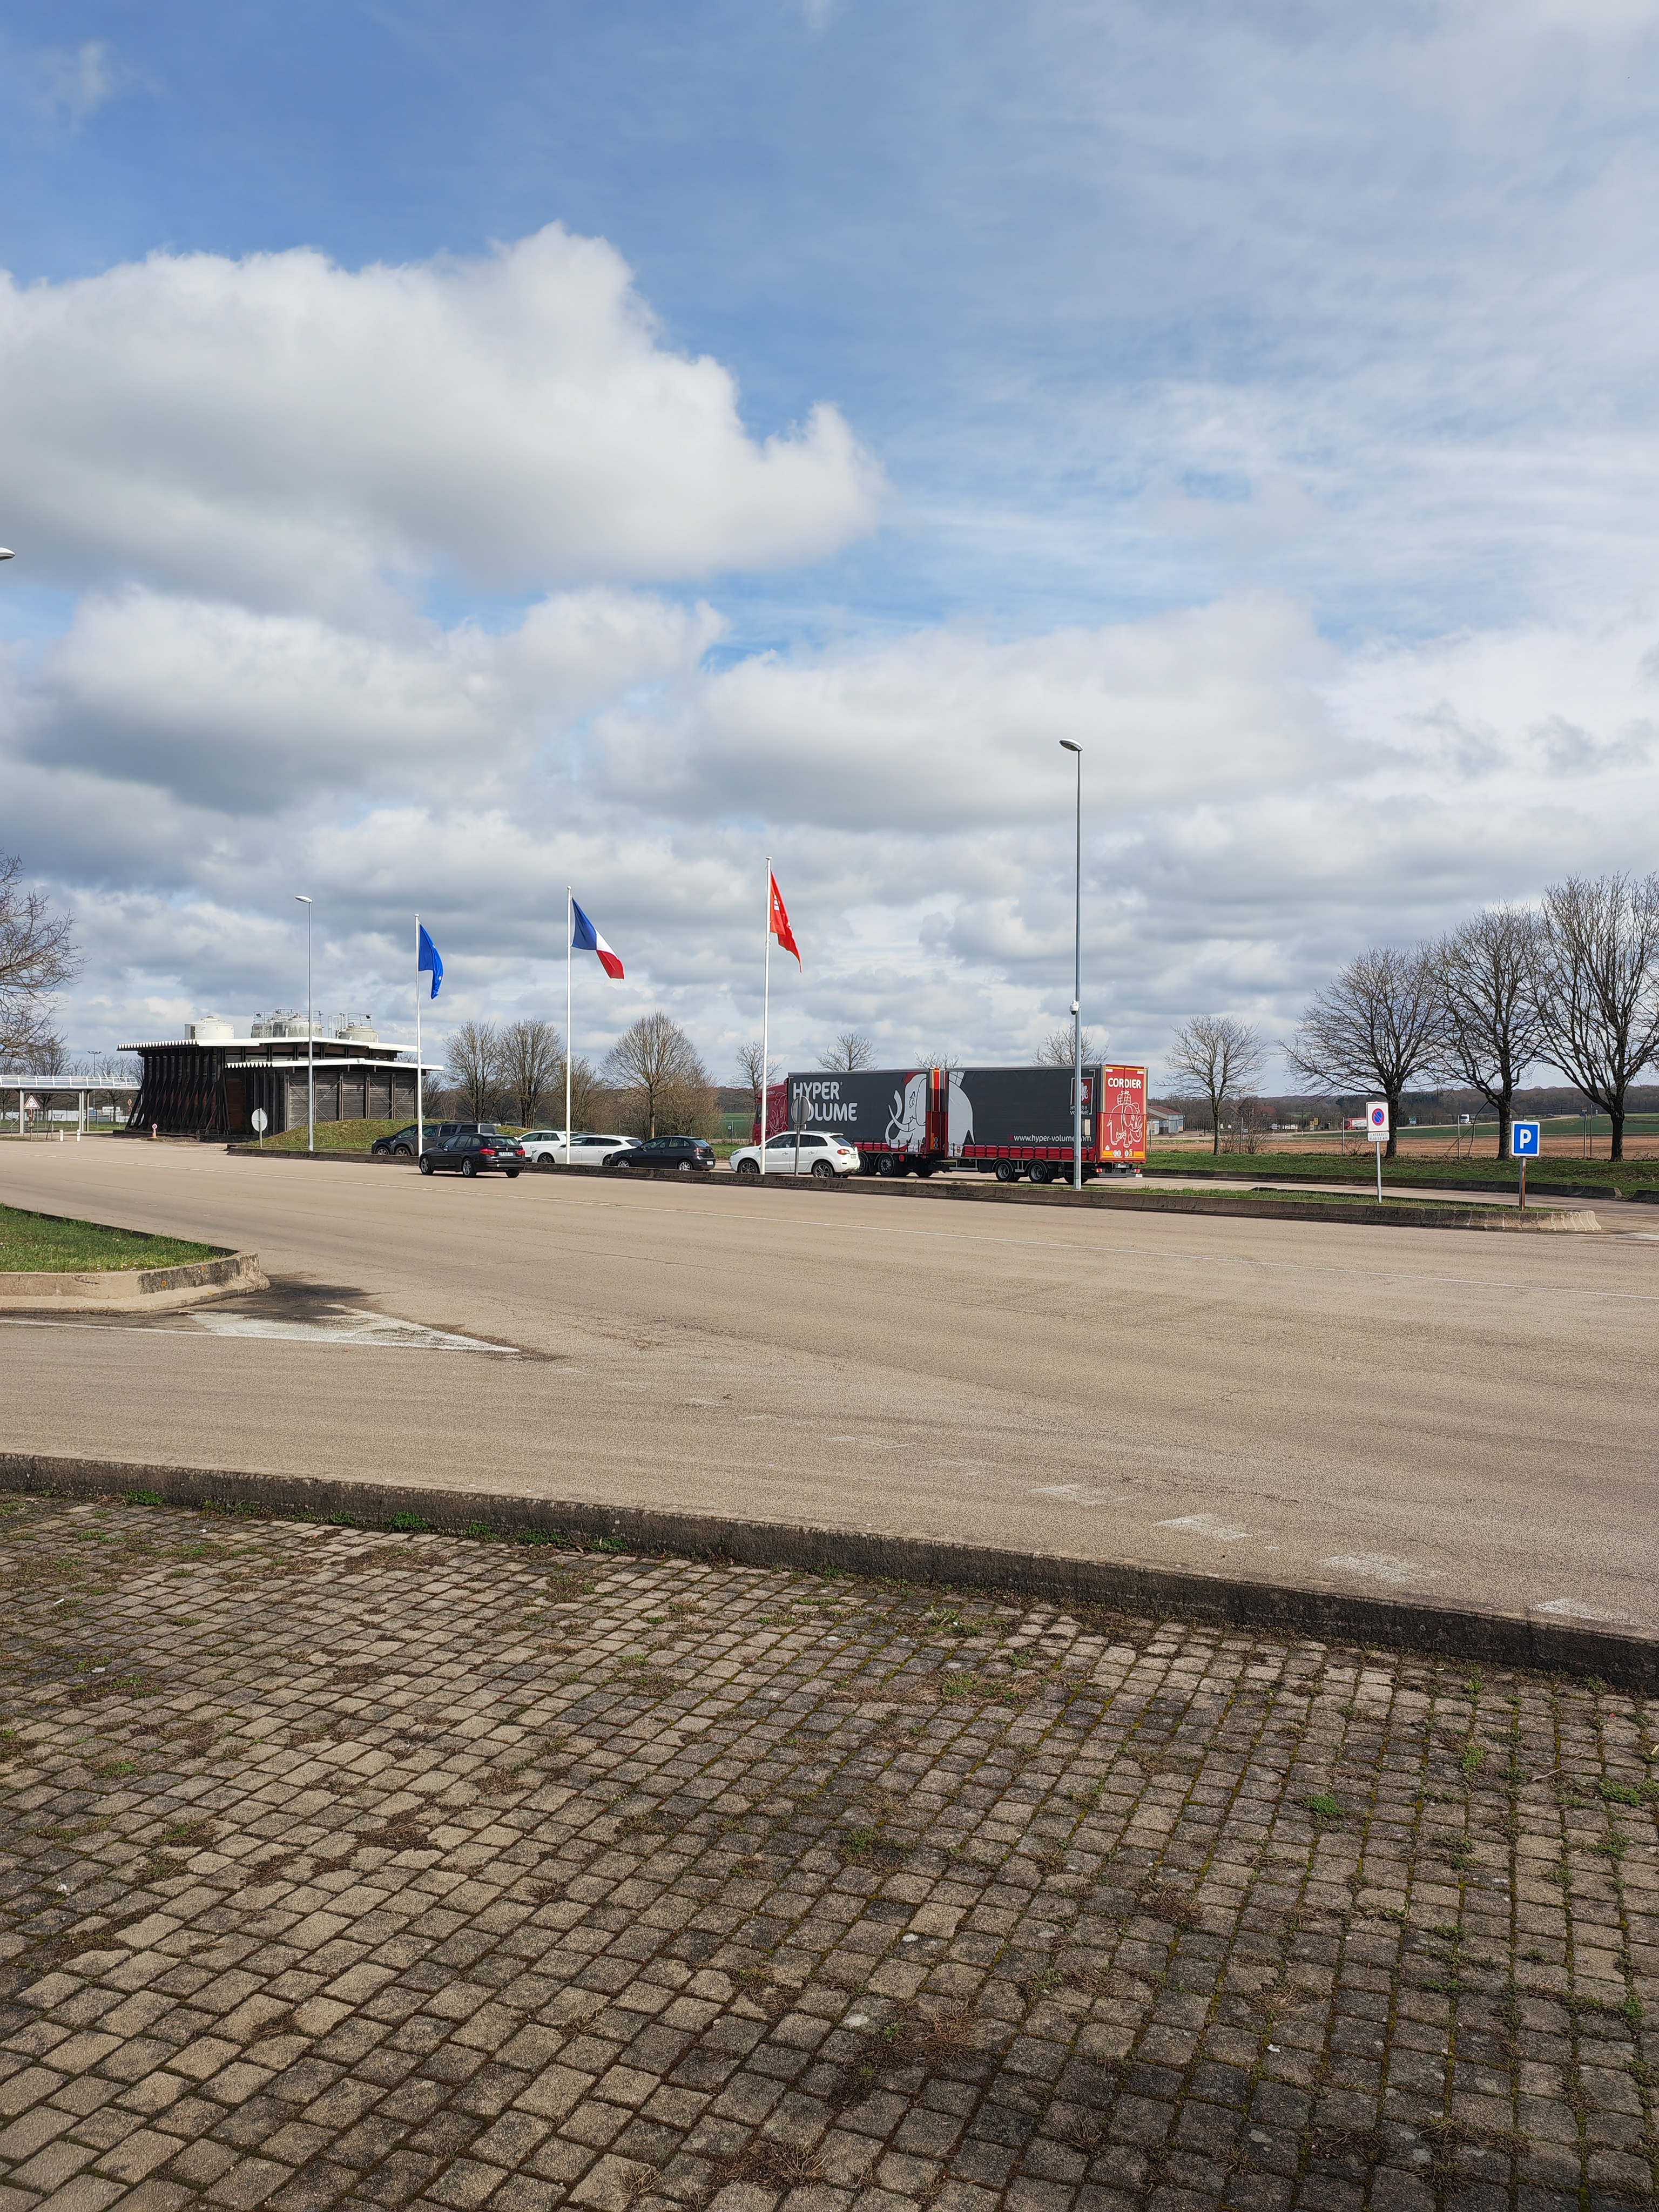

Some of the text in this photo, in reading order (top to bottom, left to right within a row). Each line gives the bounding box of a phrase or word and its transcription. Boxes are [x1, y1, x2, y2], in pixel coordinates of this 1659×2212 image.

[1108, 1077, 1142, 1089] CORDIER
[806, 1103, 858, 1122] OLUME
[1520, 1129, 1532, 1149] P
